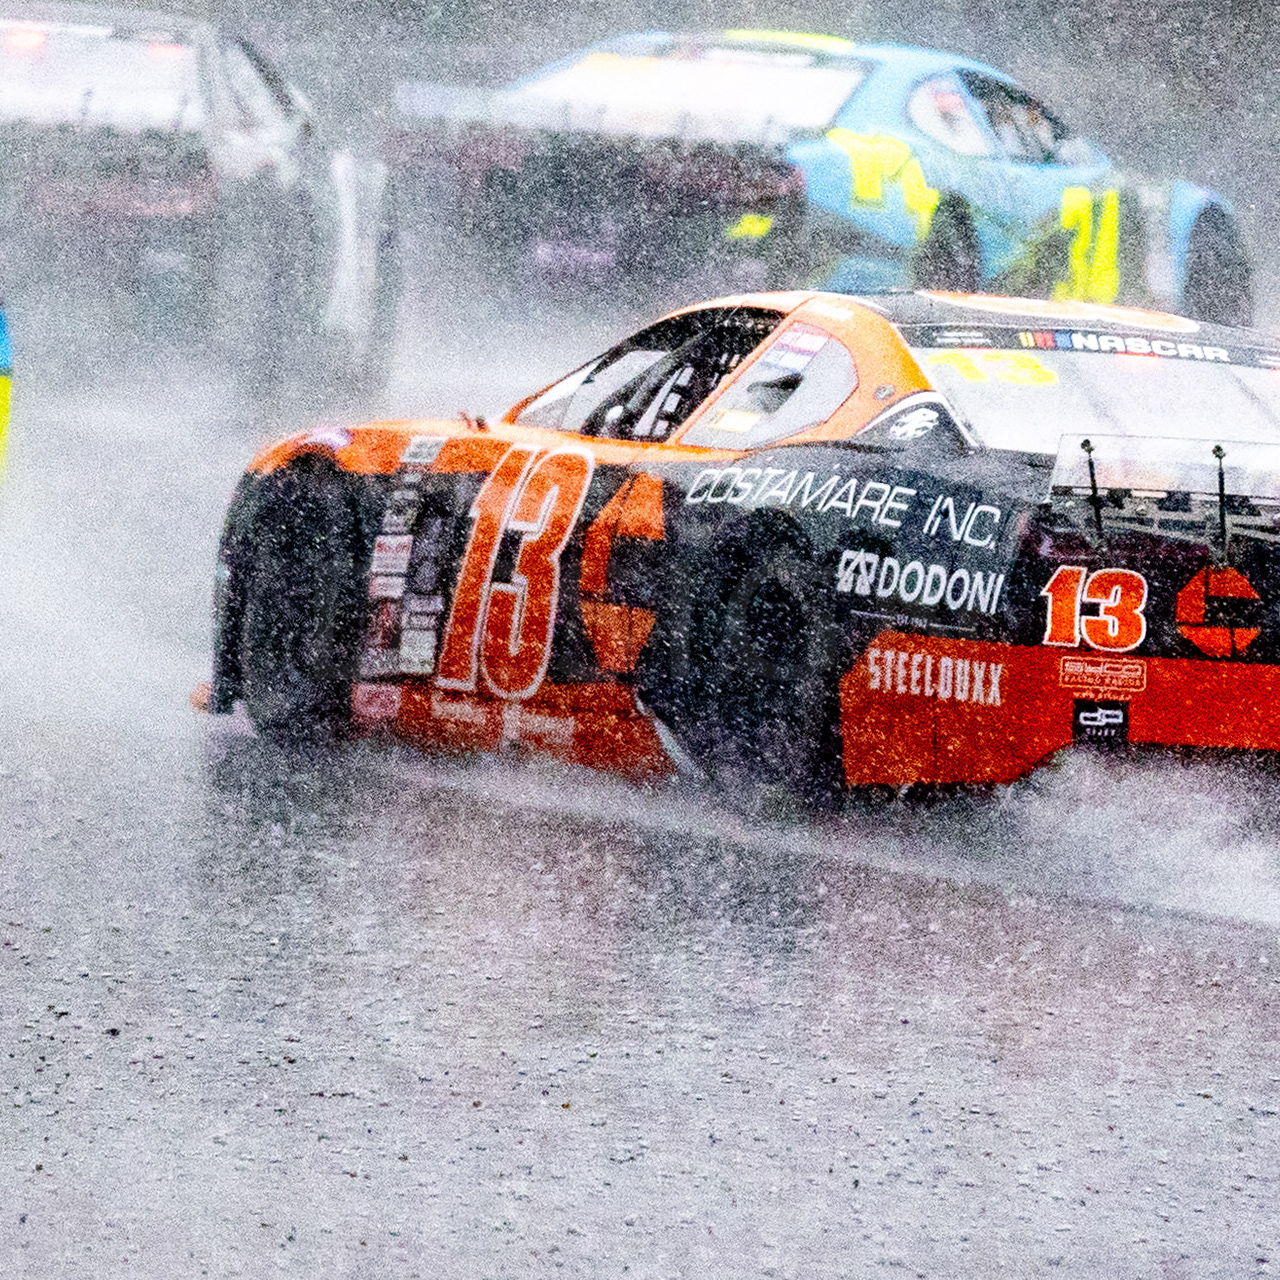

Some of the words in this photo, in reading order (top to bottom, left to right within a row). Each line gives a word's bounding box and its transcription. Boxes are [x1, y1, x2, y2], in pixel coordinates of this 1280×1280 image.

[927, 350, 1058, 386] 13
[1072, 332, 1230, 362] NASCAR
[686, 467, 916, 527] COSTAMARE
[923, 495, 1001, 550] INC.
[435, 443, 594, 700] 13
[877, 556, 1005, 615] DODONI
[1040, 565, 1148, 652] 13
